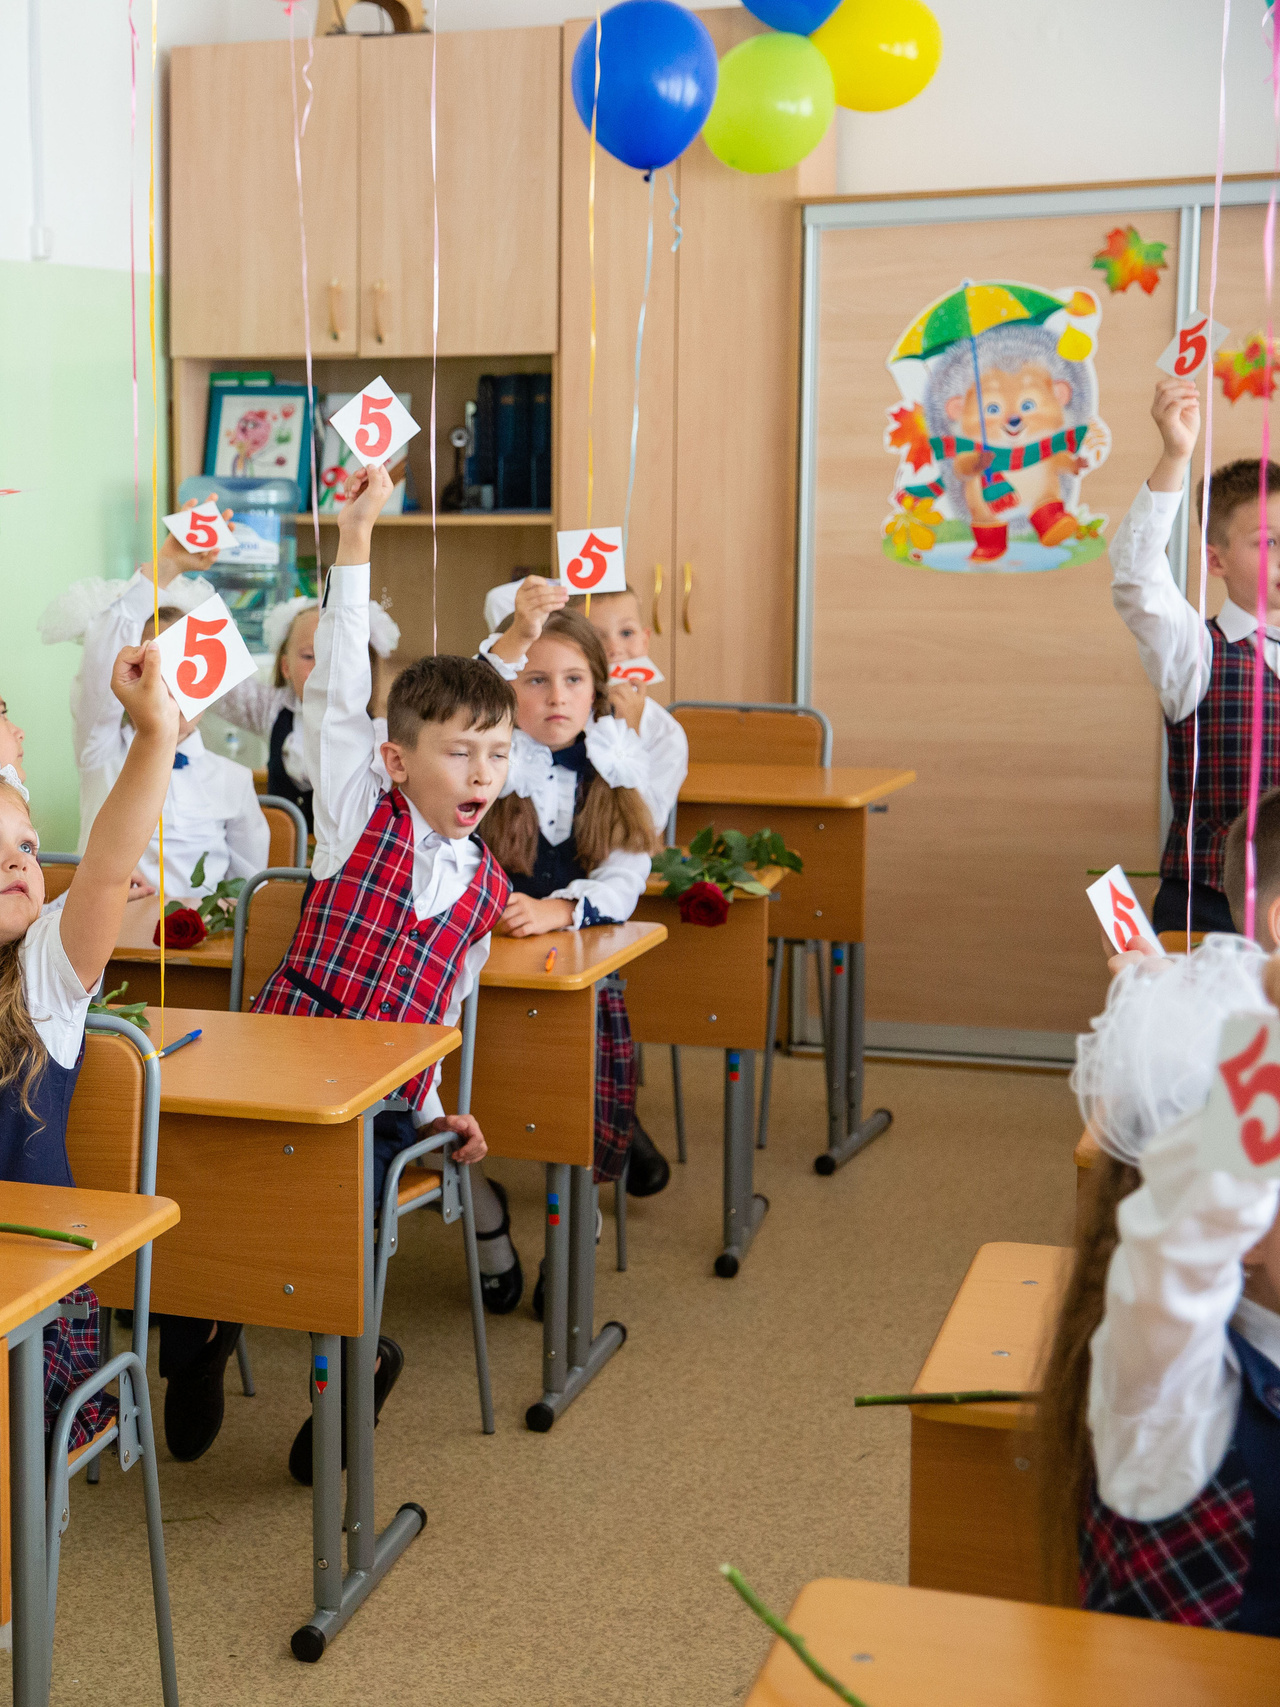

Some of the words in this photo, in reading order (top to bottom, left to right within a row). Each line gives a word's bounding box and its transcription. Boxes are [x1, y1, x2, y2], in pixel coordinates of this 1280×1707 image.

[1173, 318, 1208, 377] 5
[355, 393, 393, 458] 5
[185, 512, 219, 548] 5
[566, 532, 619, 589] 5
[176, 615, 228, 700] 5
[1108, 879, 1141, 953] 5
[1220, 1025, 1280, 1166] 5
